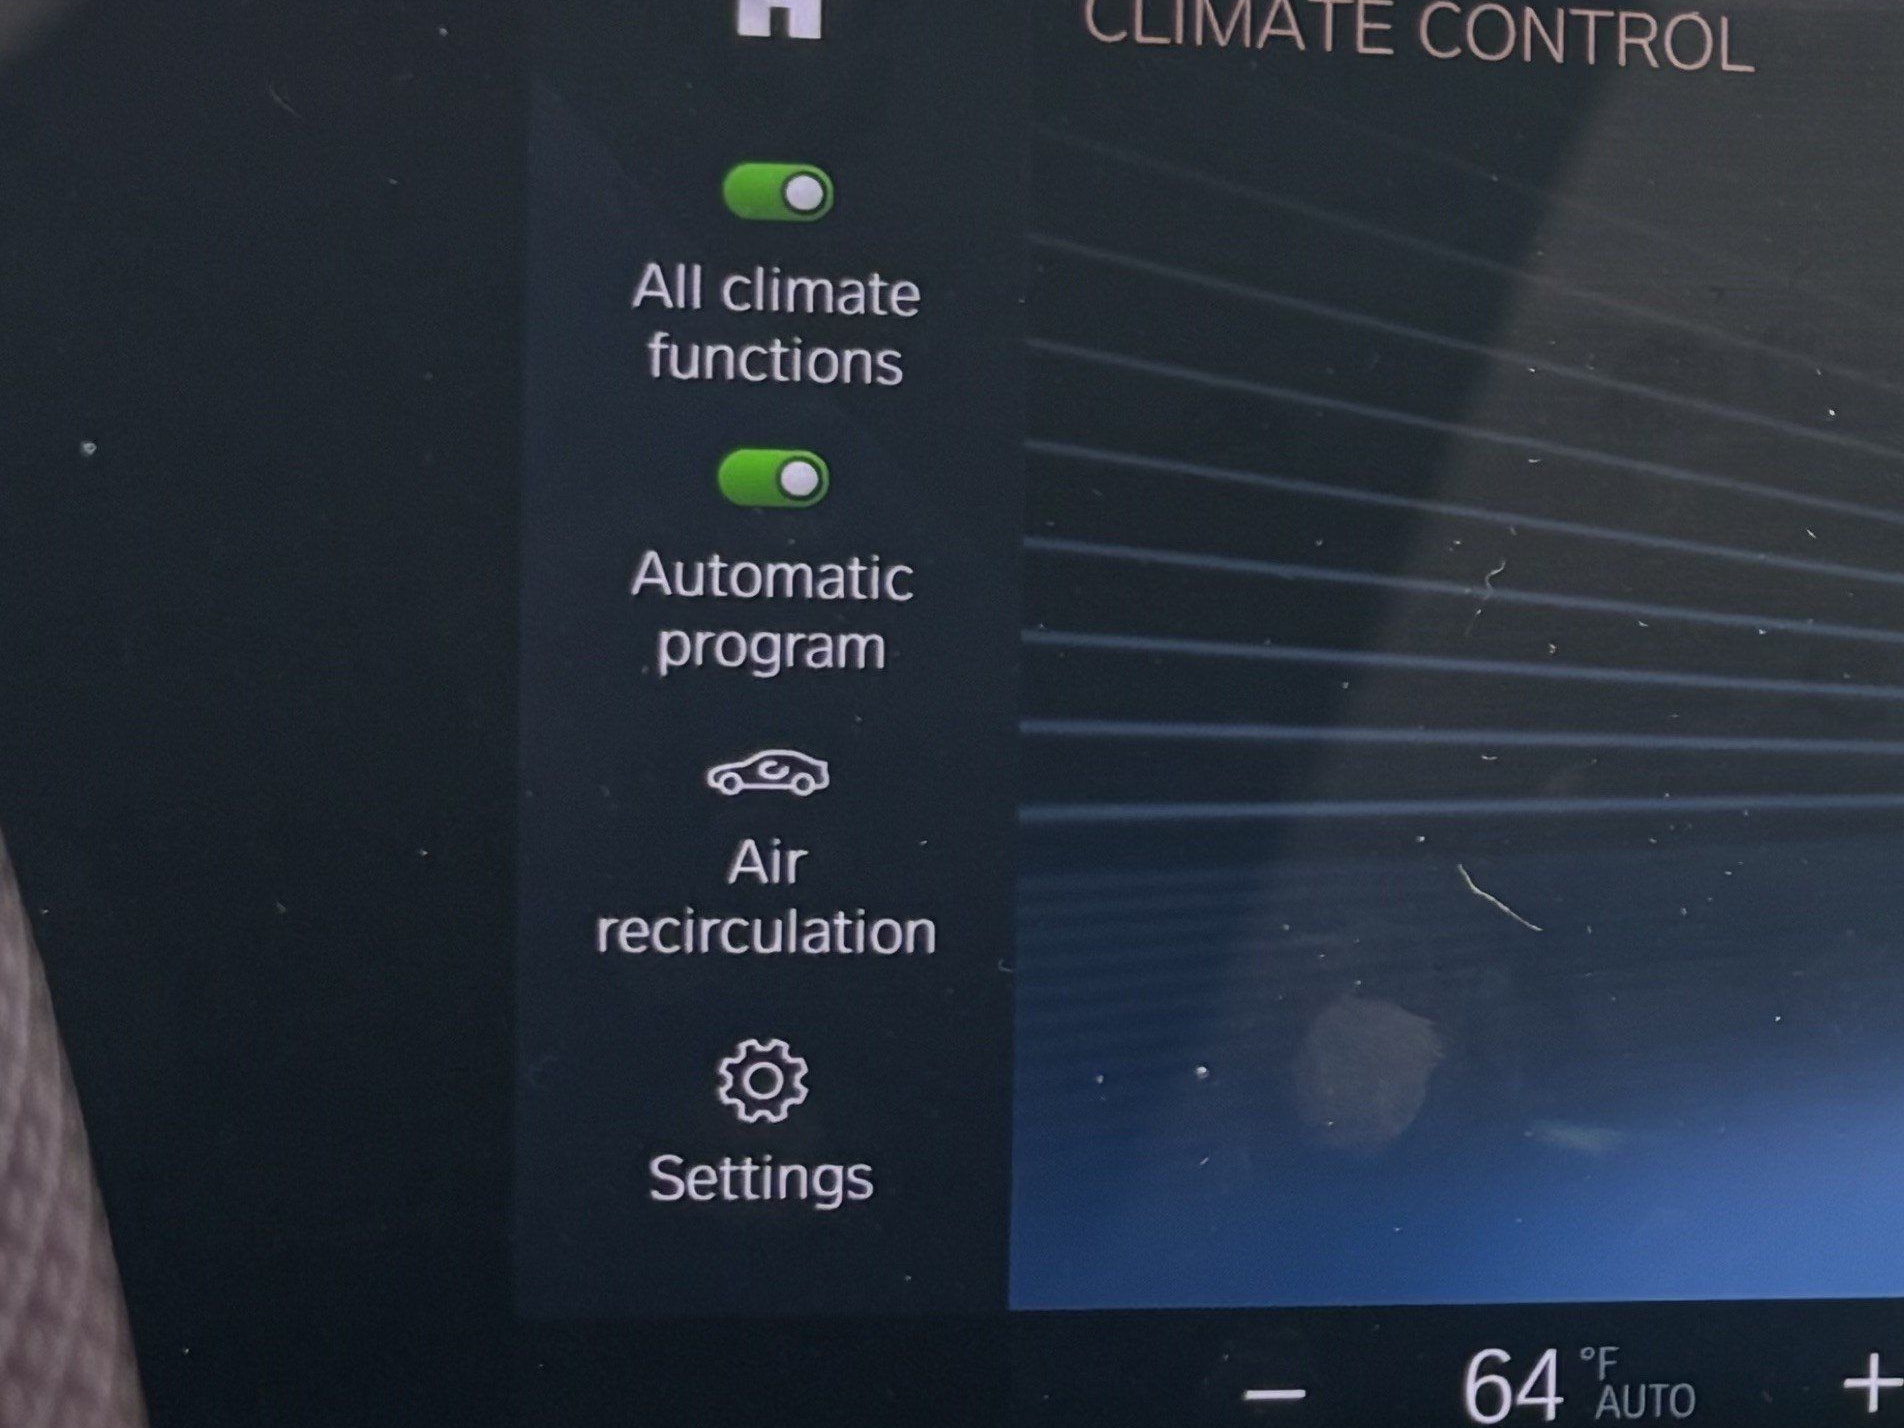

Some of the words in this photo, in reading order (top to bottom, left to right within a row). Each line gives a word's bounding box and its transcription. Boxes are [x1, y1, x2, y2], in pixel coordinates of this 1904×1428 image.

[1419, 0, 1756, 74] CONTROL
[631, 262, 706, 313] All
[721, 267, 922, 319] climate
[647, 331, 906, 387] functions
[631, 550, 916, 604] Automatic
[656, 620, 887, 680] program
[727, 838, 807, 884] Air
[595, 909, 937, 956] recirculation
[648, 1154, 874, 1210] Settings
[1464, 1346, 1564, 1424] 64
[1595, 1382, 1697, 1420] AUTO
